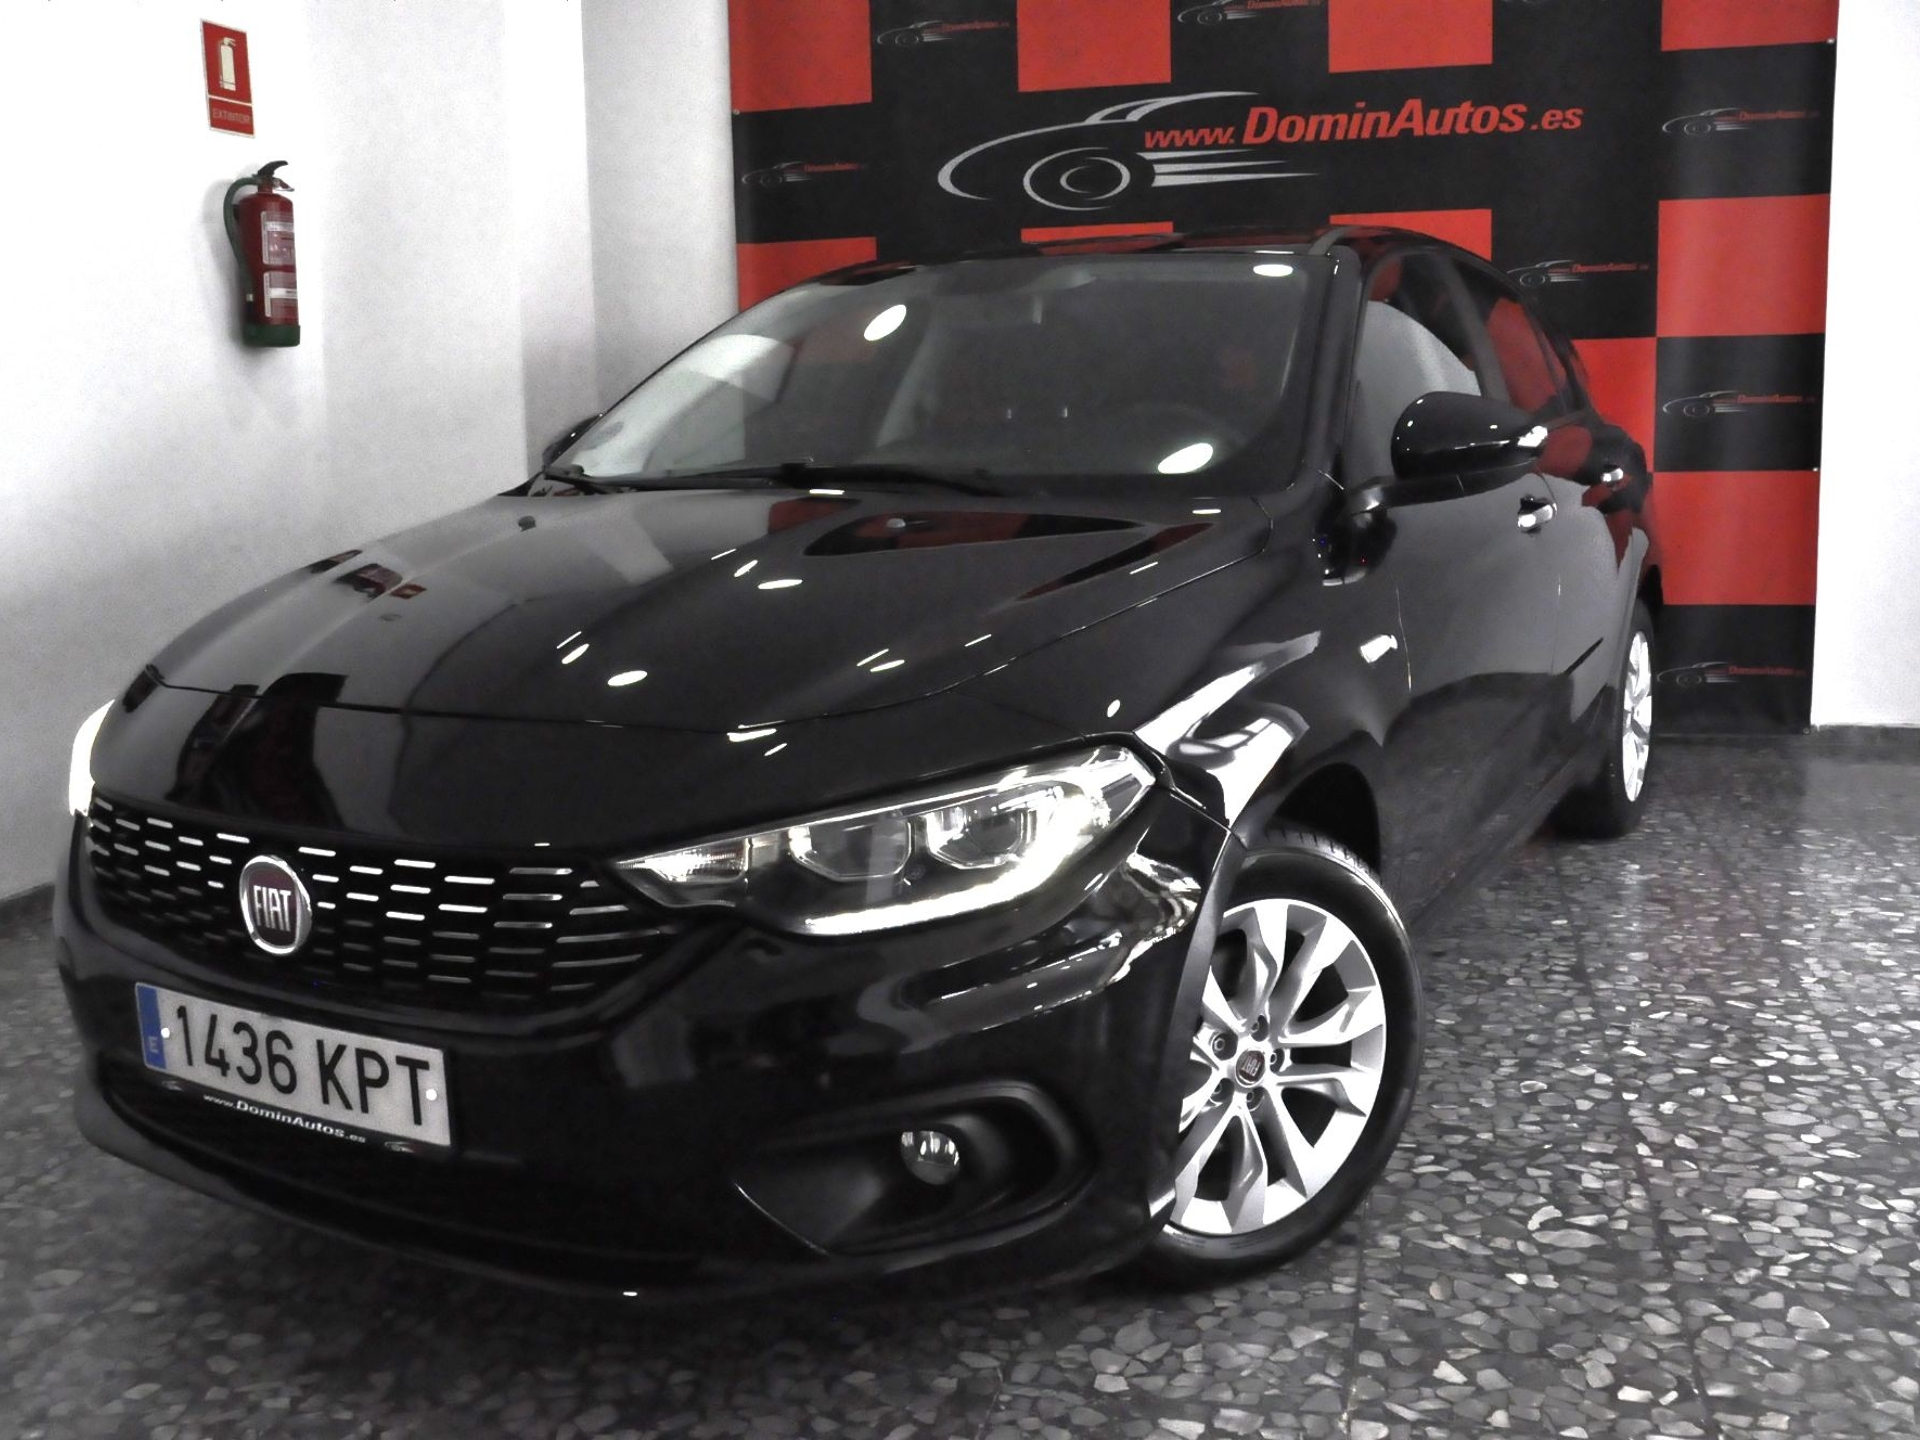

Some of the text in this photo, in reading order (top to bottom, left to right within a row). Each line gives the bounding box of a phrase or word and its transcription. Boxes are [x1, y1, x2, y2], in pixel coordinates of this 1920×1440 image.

[253, 885, 292, 932] FIAT
[176, 1005, 430, 1126] 1436 KPT
